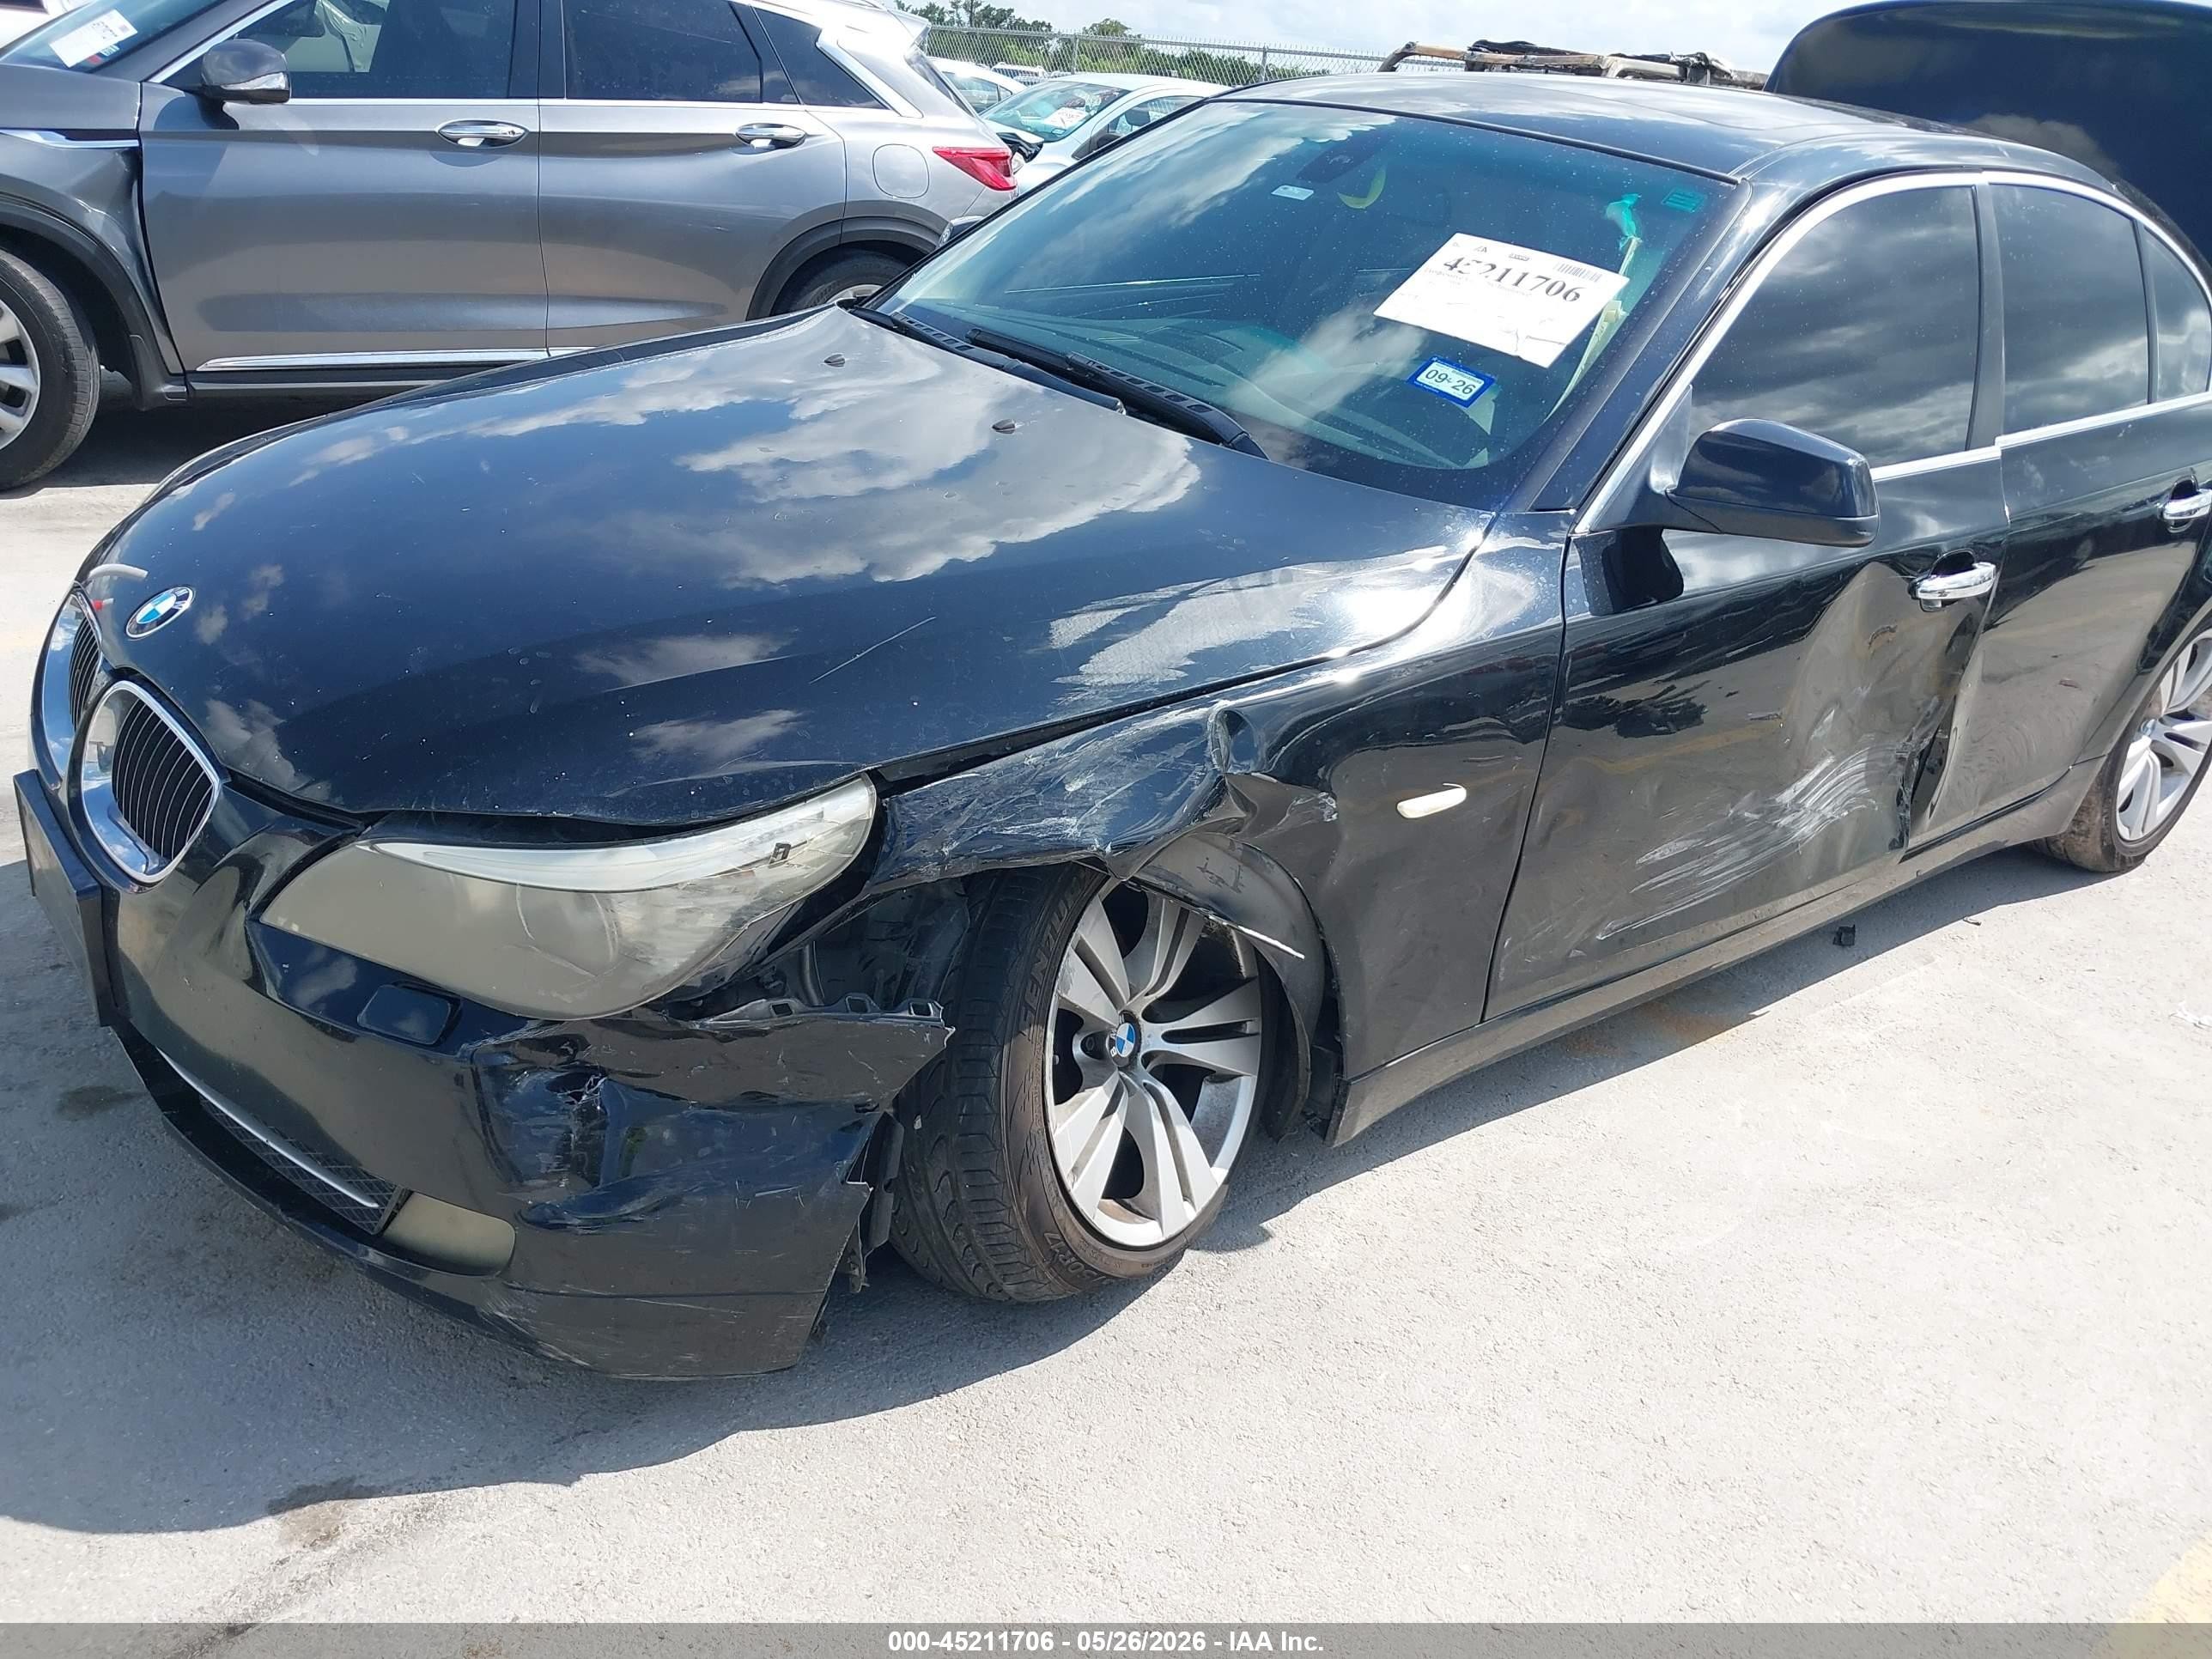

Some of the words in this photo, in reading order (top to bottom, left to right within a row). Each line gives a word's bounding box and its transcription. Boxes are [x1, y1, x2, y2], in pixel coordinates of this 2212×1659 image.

[1443, 257, 1585, 301] 45211706
[1425, 369, 1449, 383] 09
[1451, 380, 1476, 394] 26
